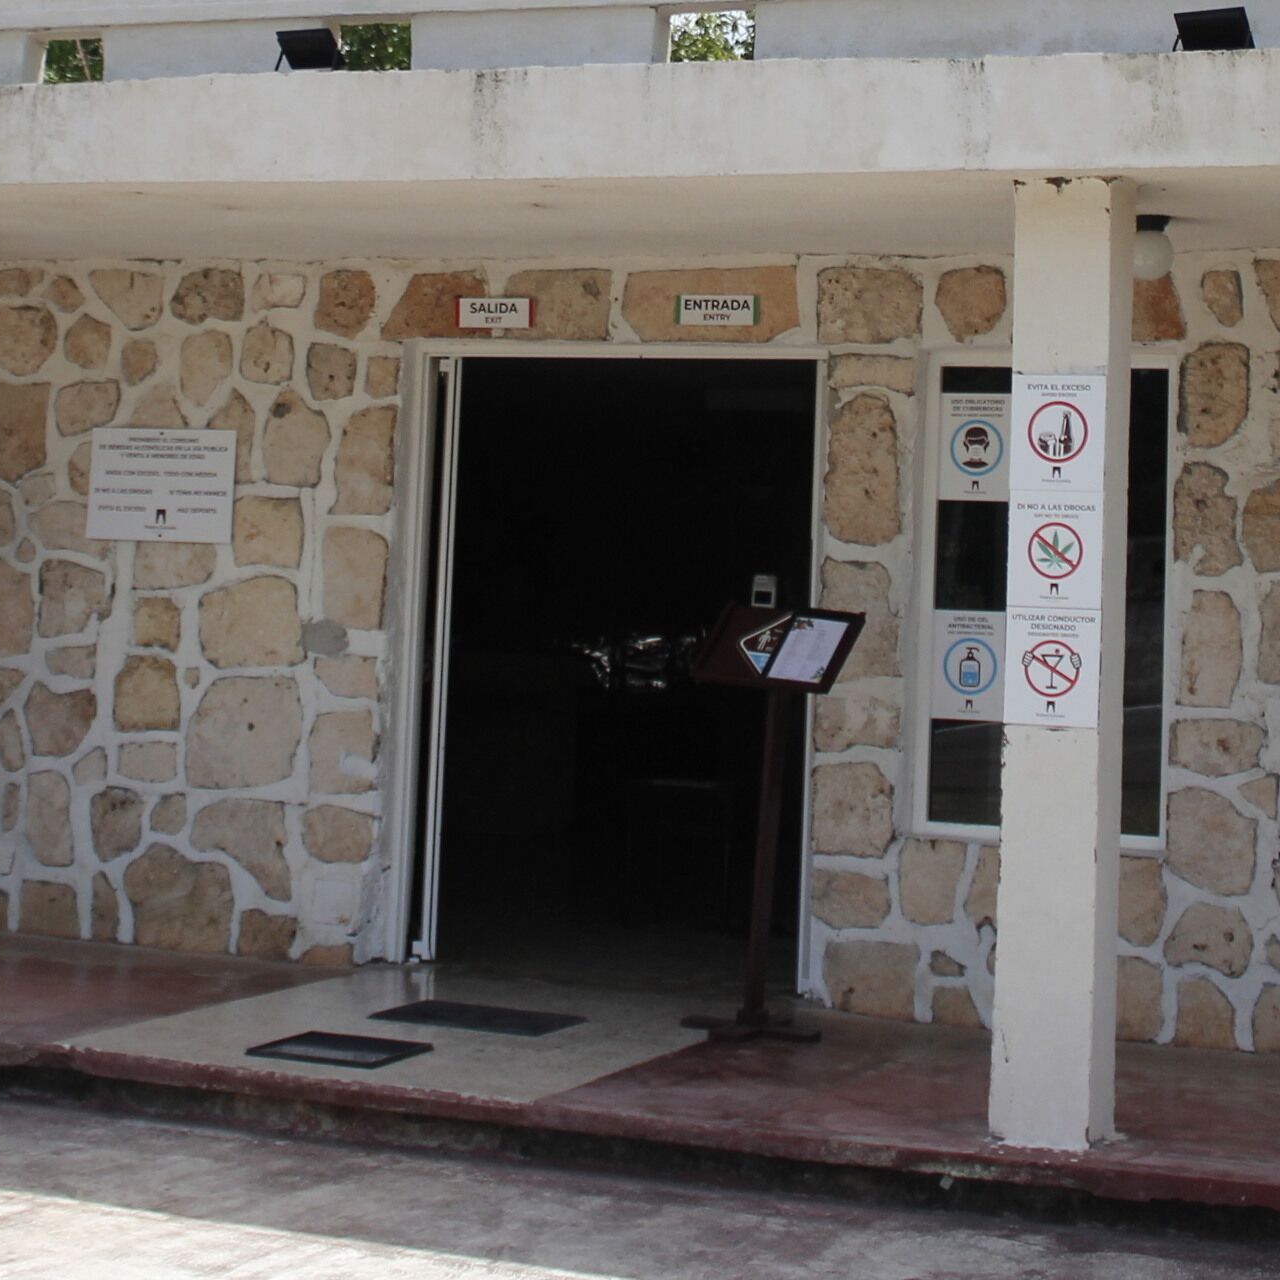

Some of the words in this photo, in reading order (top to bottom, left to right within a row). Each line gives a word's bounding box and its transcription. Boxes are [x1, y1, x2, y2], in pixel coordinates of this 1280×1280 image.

[470, 303, 517, 314] SALIDA
[684, 299, 750, 311] ENTRADA
[703, 313, 731, 321] ENTRY
[1027, 383, 1049, 391] EVITA
[1051, 383, 1060, 391] EL
[1030, 623, 1077, 631] DESIGNADO
